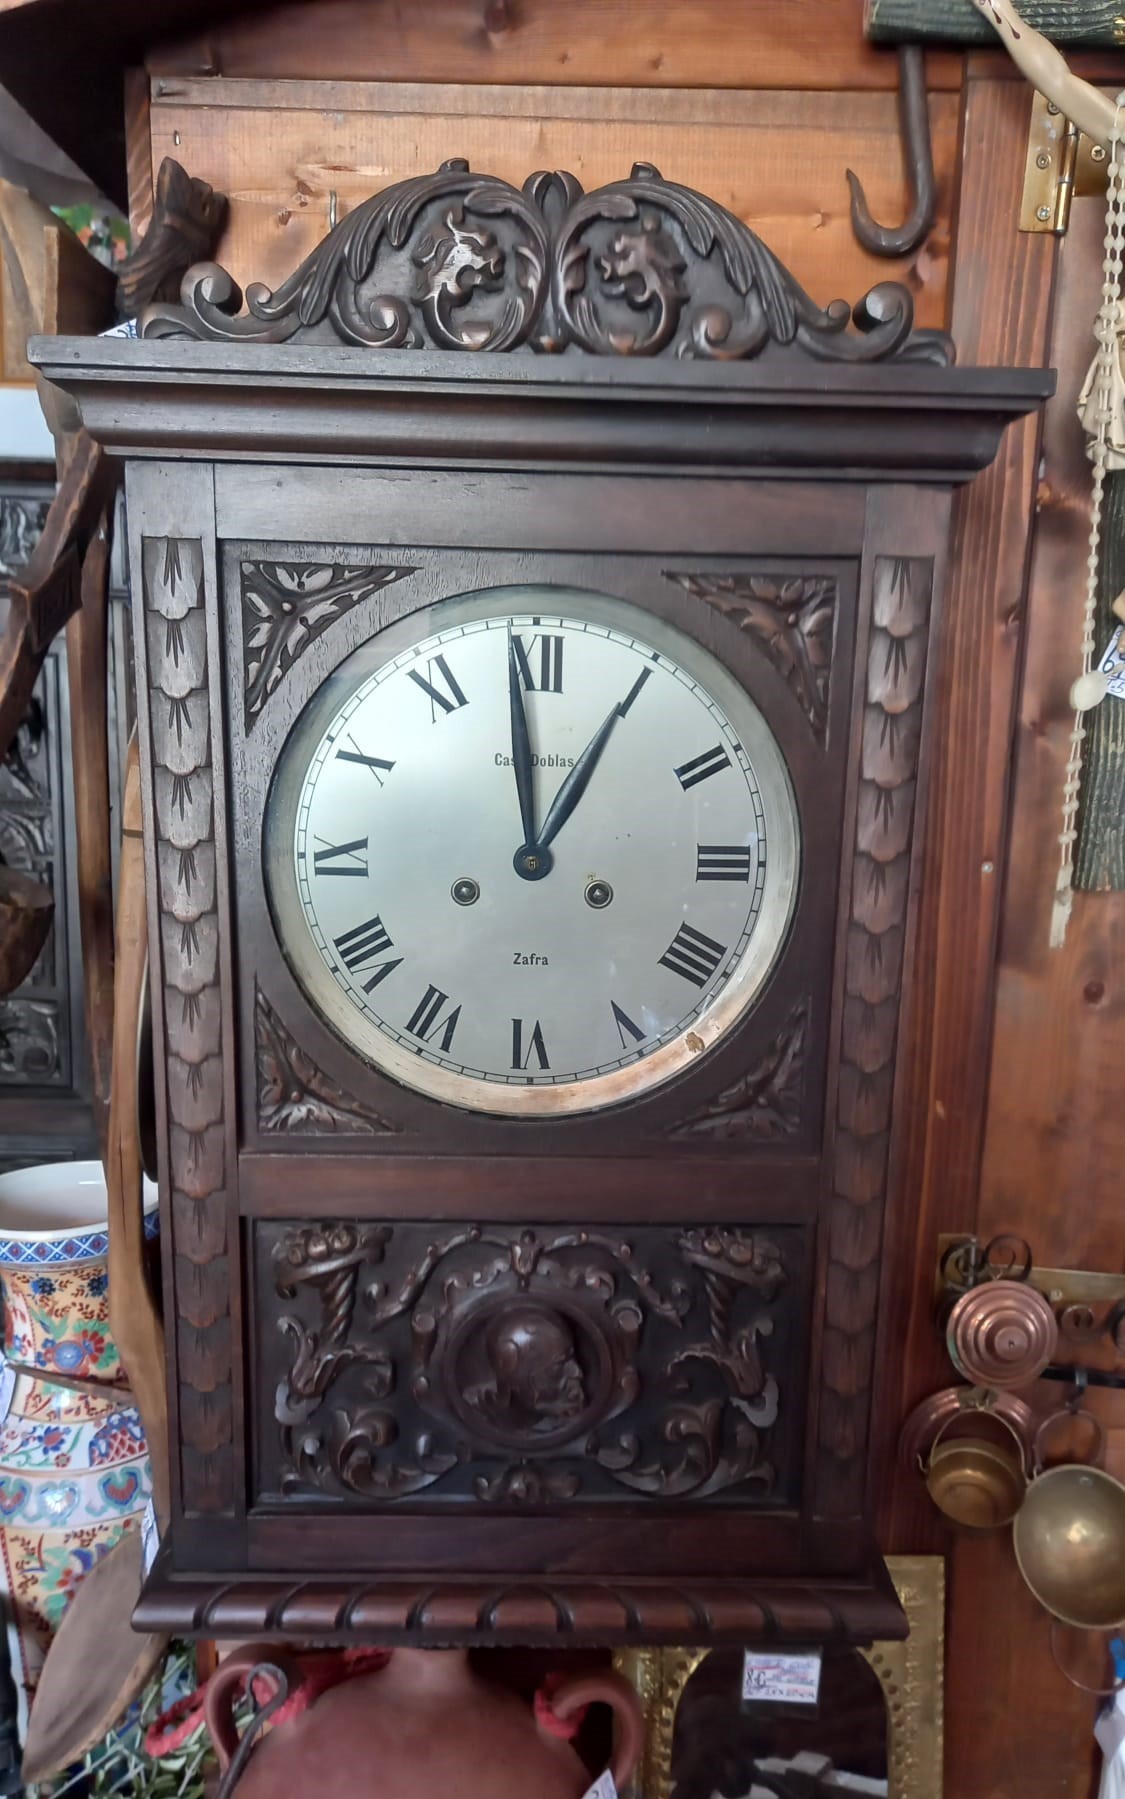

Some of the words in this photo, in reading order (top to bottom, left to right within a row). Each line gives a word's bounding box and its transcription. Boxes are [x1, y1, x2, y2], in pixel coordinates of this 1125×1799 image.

[406, 653, 470, 724] XI
[335, 733, 396, 787] X
[530, 754, 575, 768] Doblas
[673, 743, 732, 791] II
[314, 835, 369, 878] IX
[696, 843, 750, 884] III
[513, 952, 549, 966] Zafra
[657, 921, 728, 989] IIII
[404, 984, 462, 1053] VII
[610, 1000, 646, 1049] V
